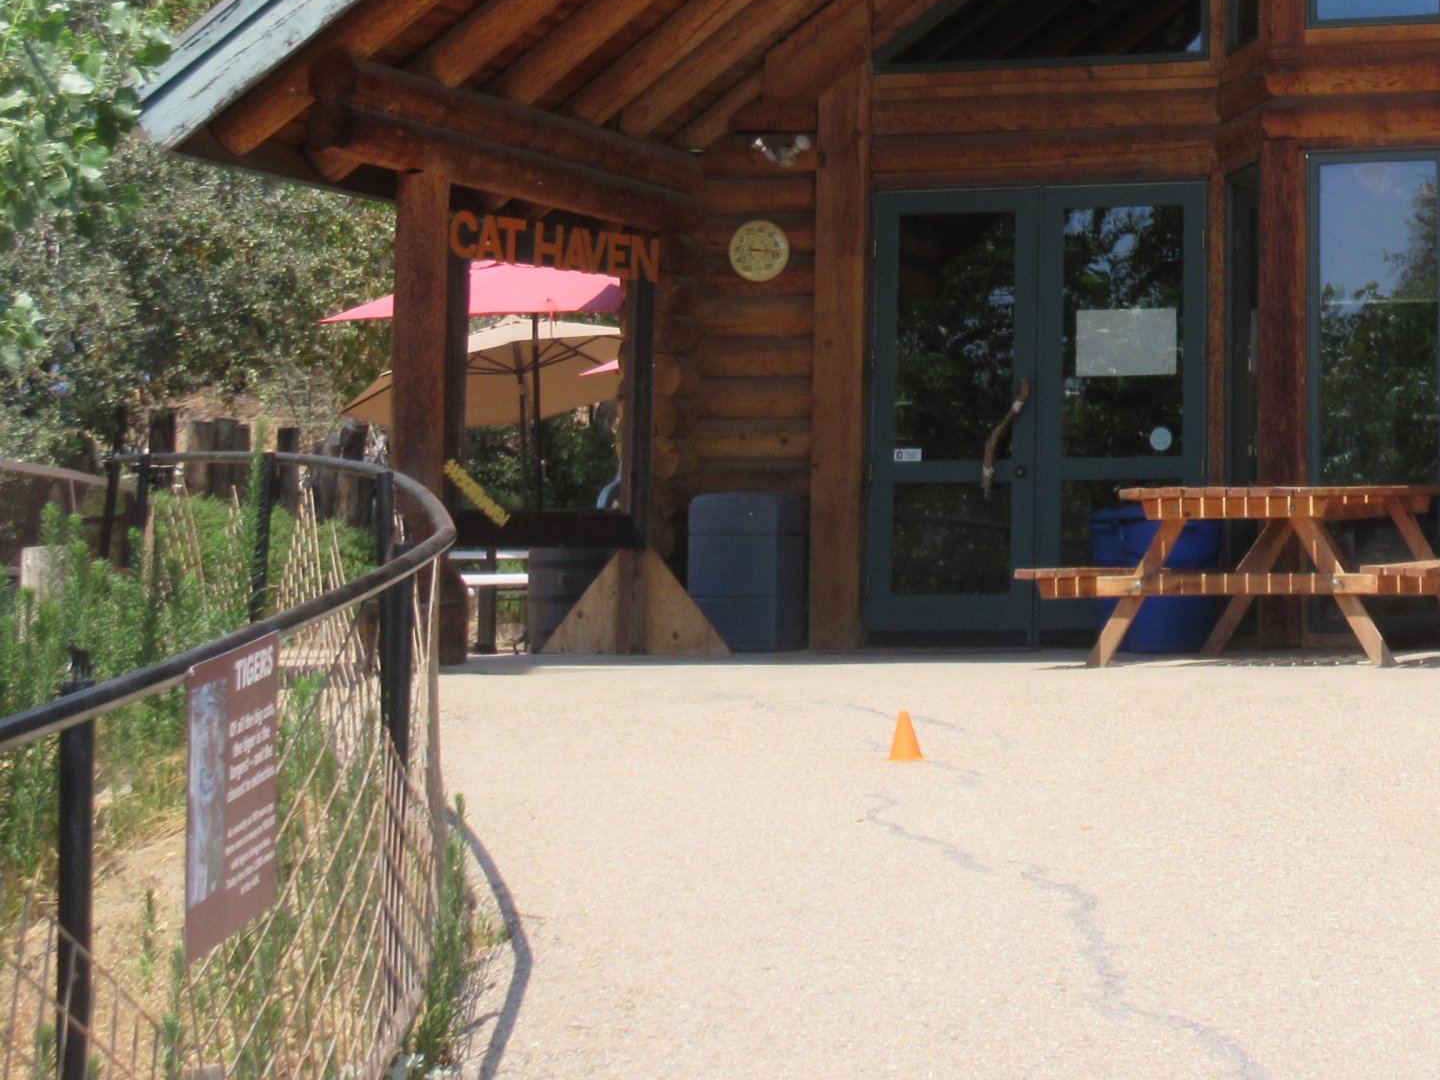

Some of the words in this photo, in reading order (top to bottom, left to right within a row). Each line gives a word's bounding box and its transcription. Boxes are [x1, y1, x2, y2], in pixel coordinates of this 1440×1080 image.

[448, 210, 527, 264] CAT
[534, 222, 661, 282] HAVEN
[234, 644, 274, 692] TIGERS
